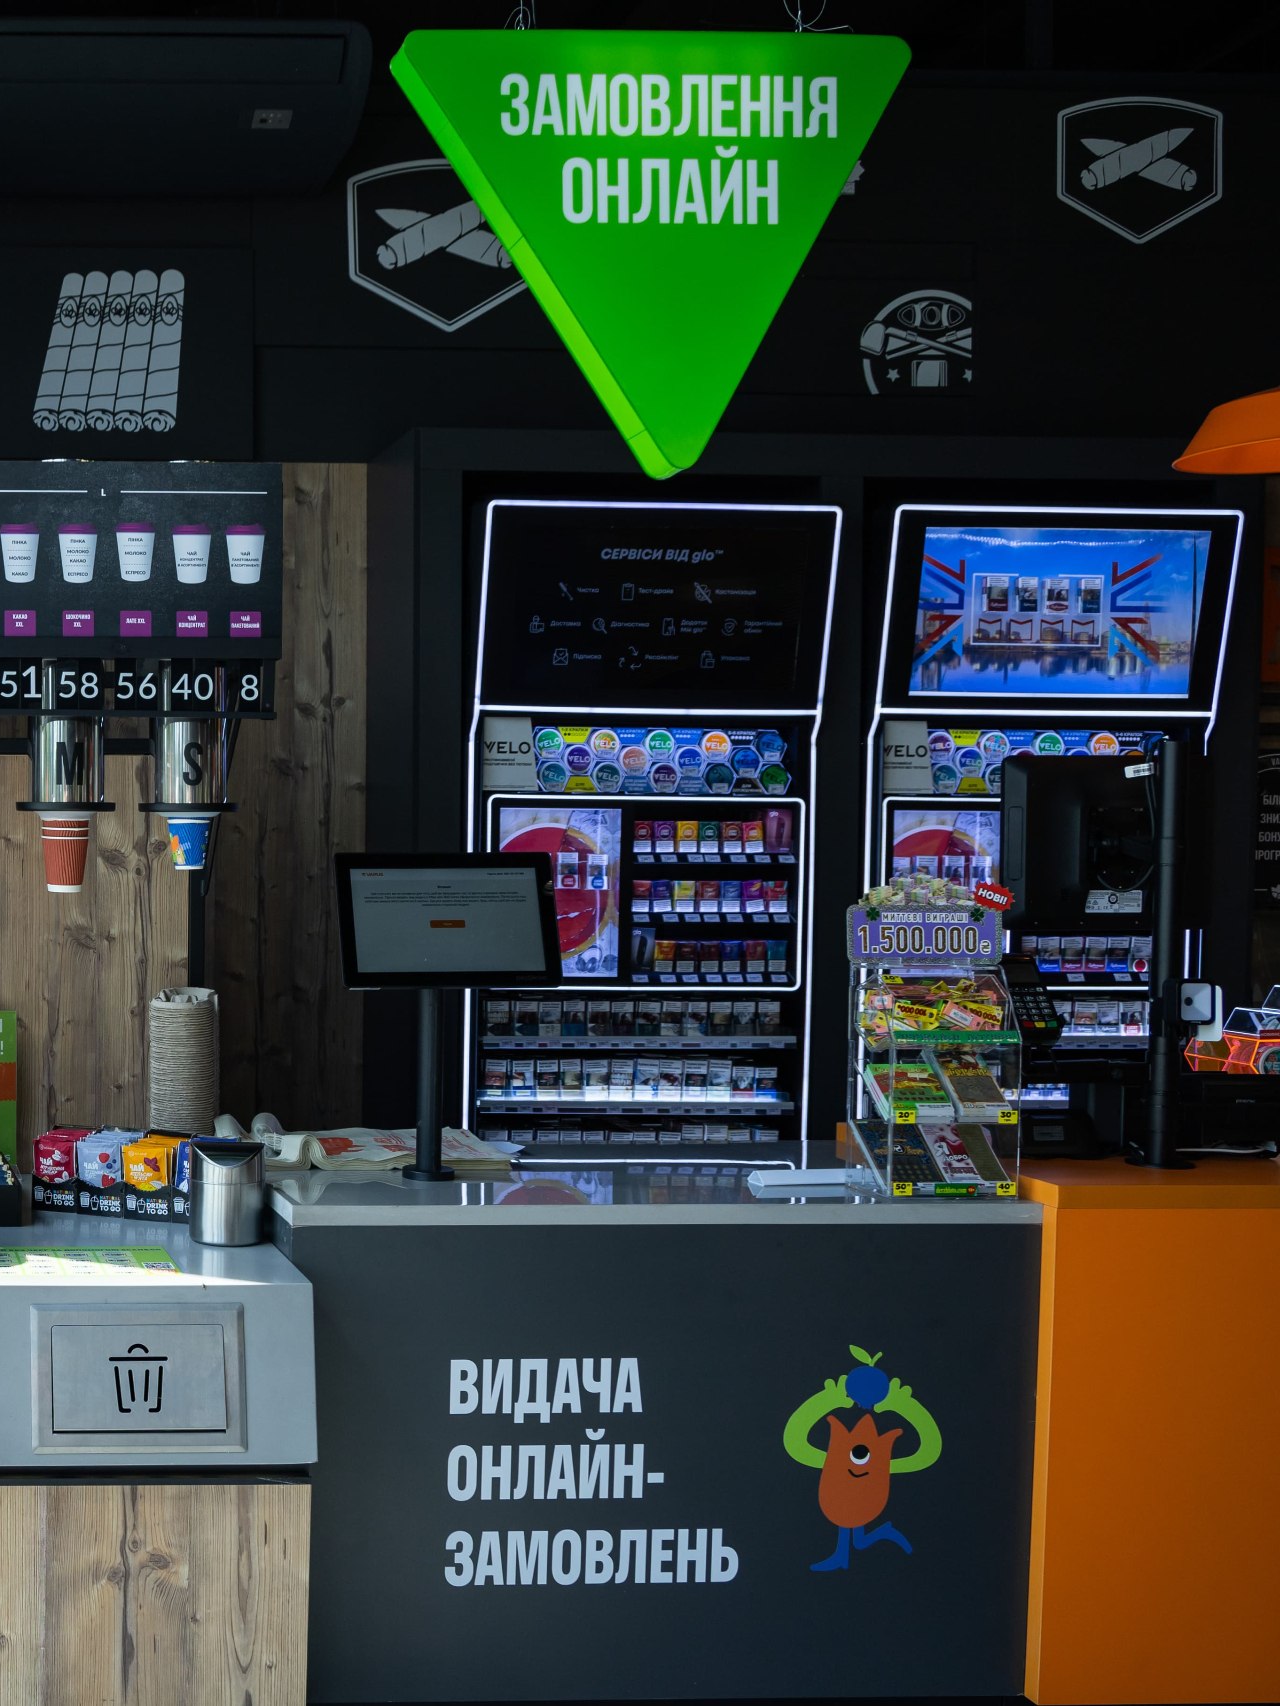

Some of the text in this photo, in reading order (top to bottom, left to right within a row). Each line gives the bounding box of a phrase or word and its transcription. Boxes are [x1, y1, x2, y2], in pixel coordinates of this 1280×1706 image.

[500, 73, 838, 138] ЗАМОВЛЕННЯ
[562, 145, 779, 225] ОНЛАЙН
[101, 489, 106, 497] L
[600, 548, 664, 560] СЕРВІСИ
[665, 549, 689, 562] ВІД
[0, 666, 42, 698] 51
[58, 671, 99, 699] 58
[116, 672, 156, 700] 56
[172, 673, 214, 700] 40
[240, 674, 259, 700] 8
[484, 741, 531, 754] VELO
[538, 738, 560, 748] VELO
[884, 745, 927, 757] VELO
[56, 742, 84, 786] M
[183, 742, 203, 786] S
[977, 887, 1008, 905] НОВІ!
[882, 913, 968, 923] МИТТЄВІ ВИГРАШІ
[449, 1358, 642, 1424] ВИДАЧА
[447, 1428, 664, 1501] ОНЛАЙН-
[444, 1528, 739, 1586] ЗАМОВЛЕНЬ
